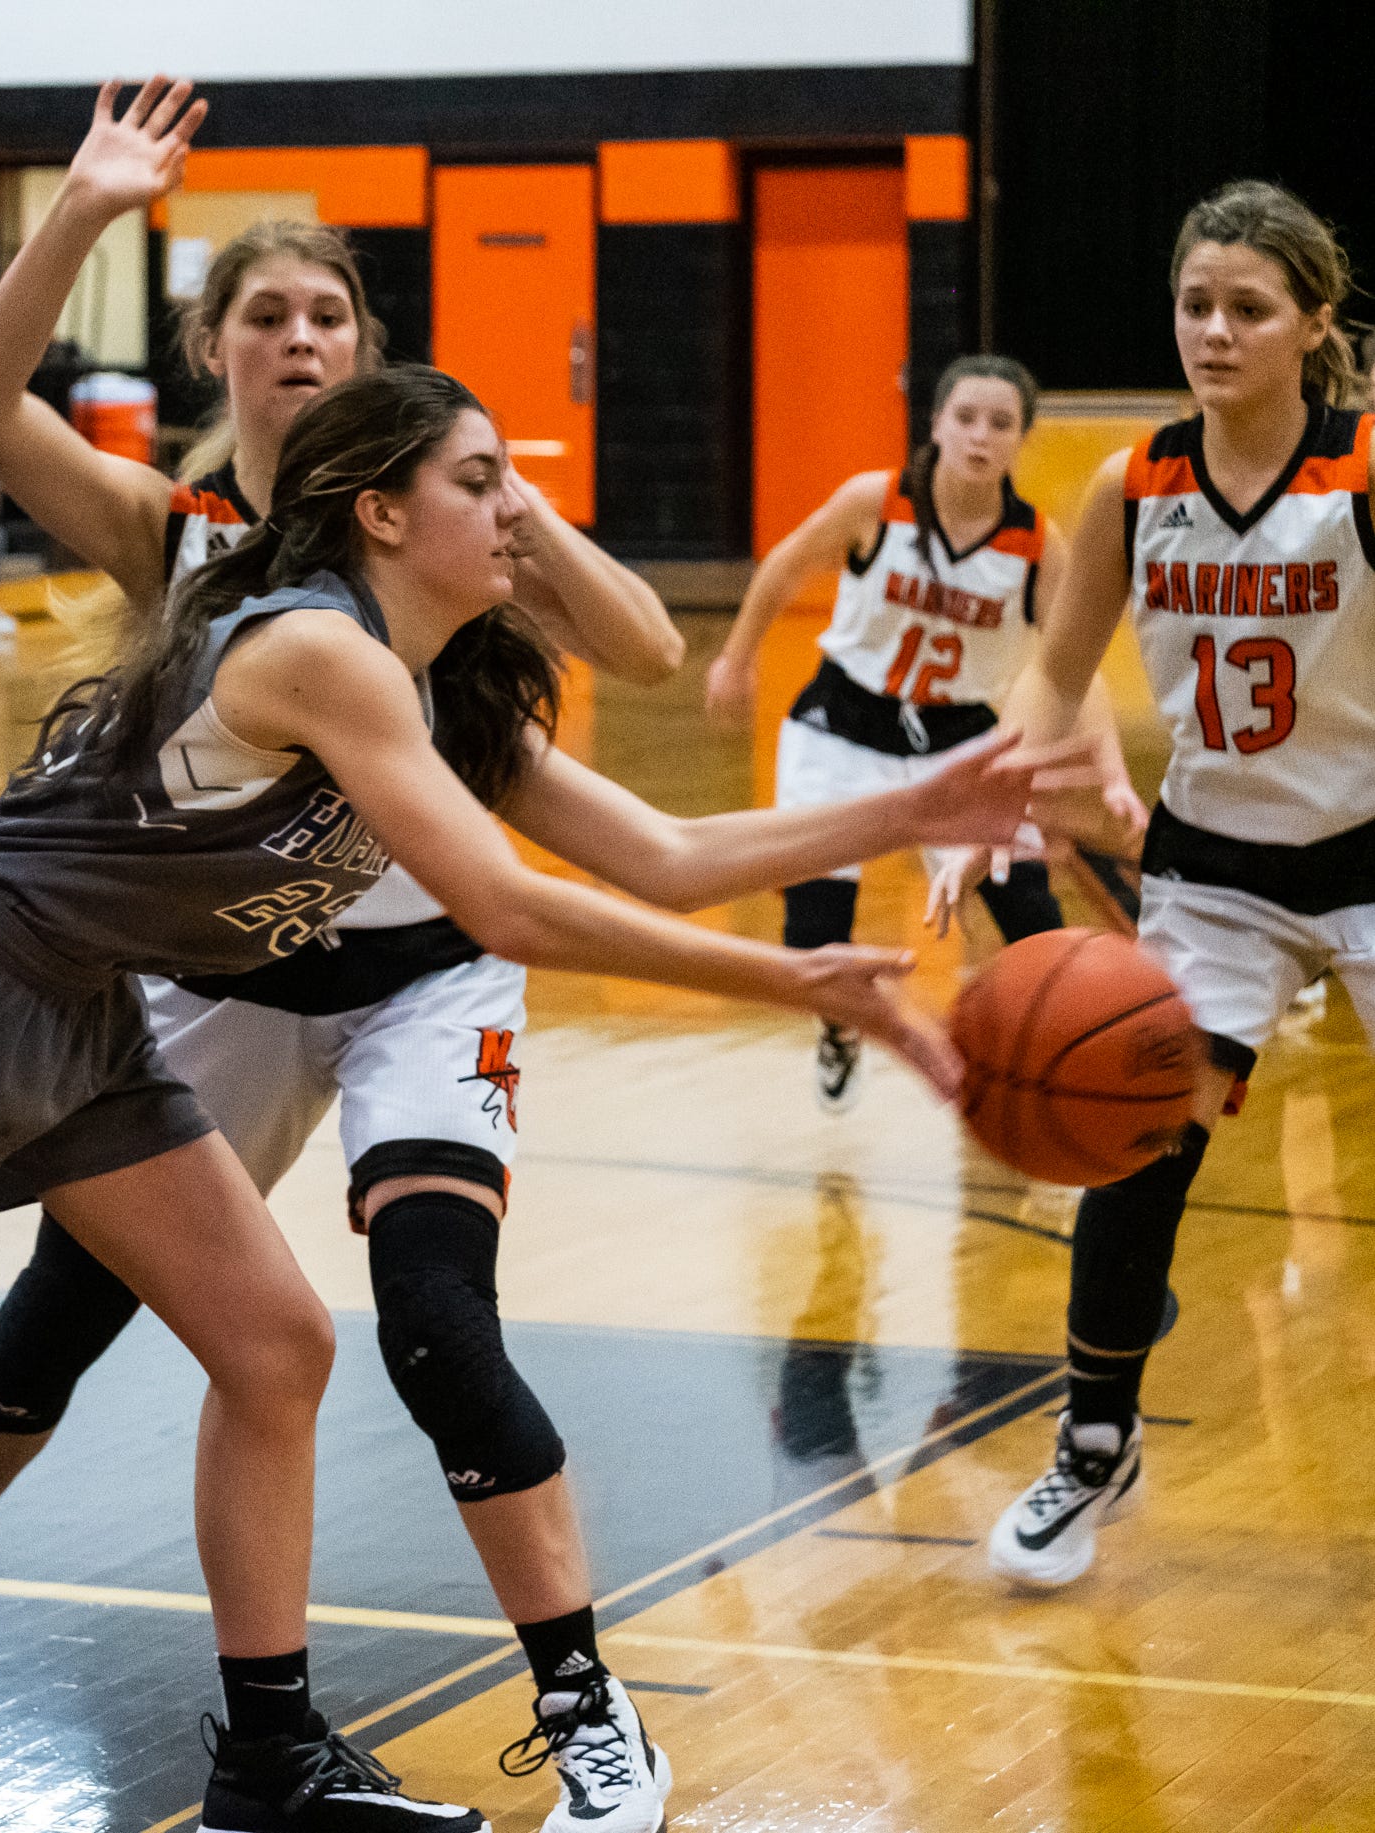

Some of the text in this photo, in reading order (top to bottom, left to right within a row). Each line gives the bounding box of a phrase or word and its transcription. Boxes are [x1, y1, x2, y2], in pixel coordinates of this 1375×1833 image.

[1146, 560, 1339, 617] MARINERS
[885, 624, 963, 706] 12
[1191, 633, 1297, 755] 13
